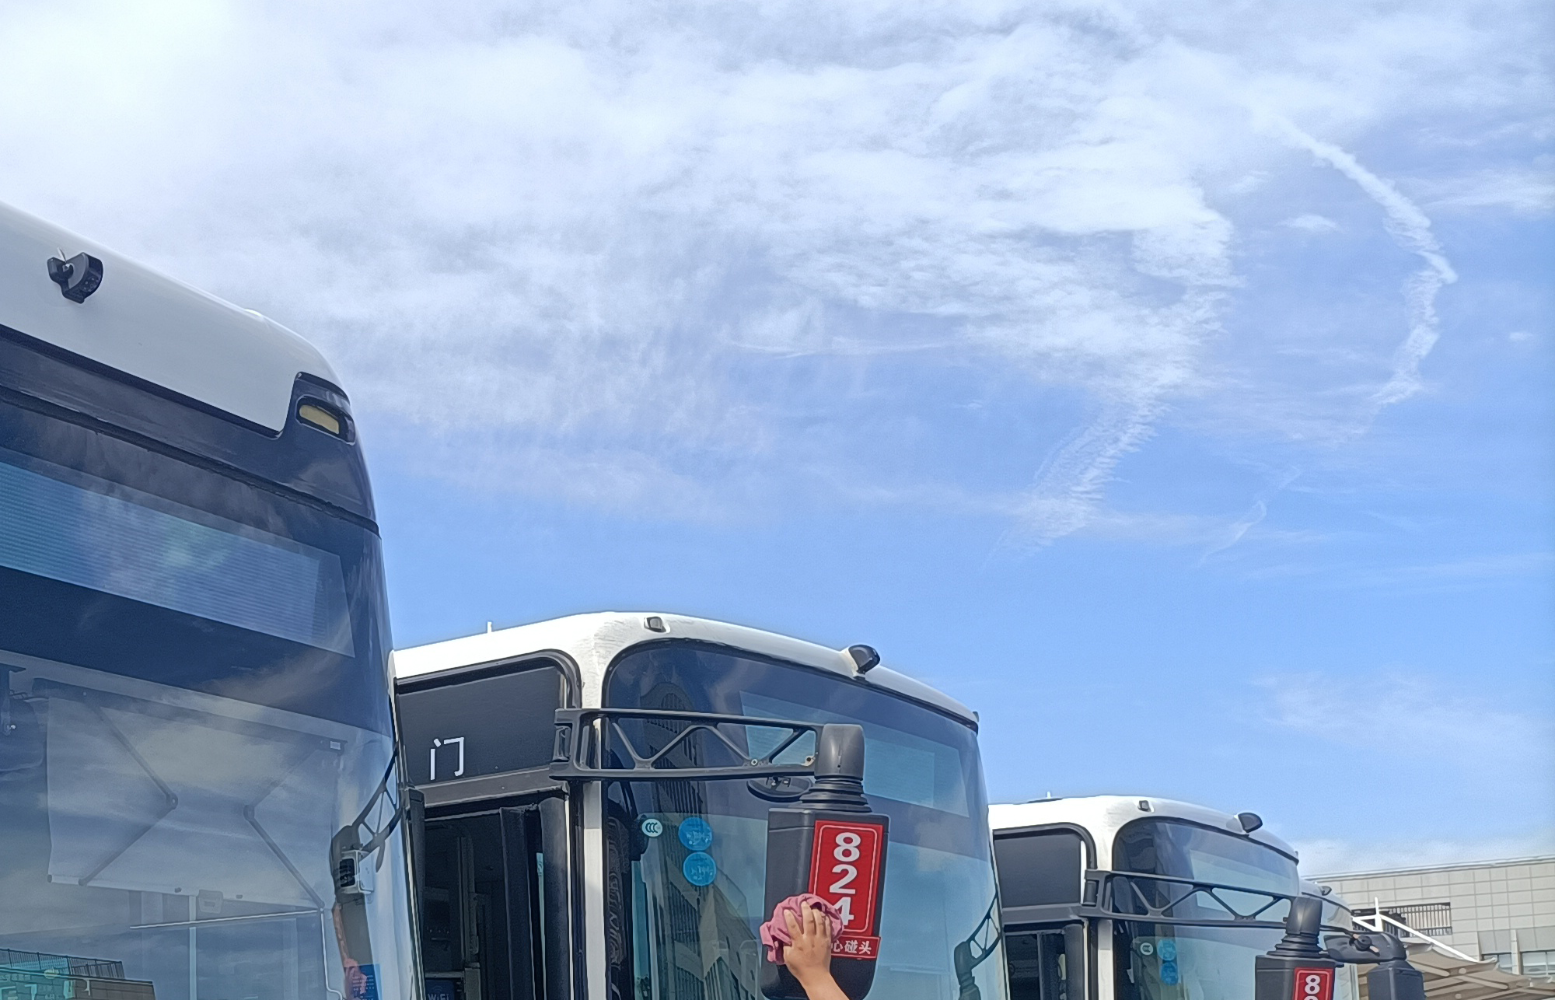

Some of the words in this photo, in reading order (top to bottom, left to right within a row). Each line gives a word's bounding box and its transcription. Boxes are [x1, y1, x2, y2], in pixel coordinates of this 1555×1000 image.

[430, 736, 465, 781] 门
[829, 831, 862, 926] 824
[831, 939, 872, 955] 心碰头
